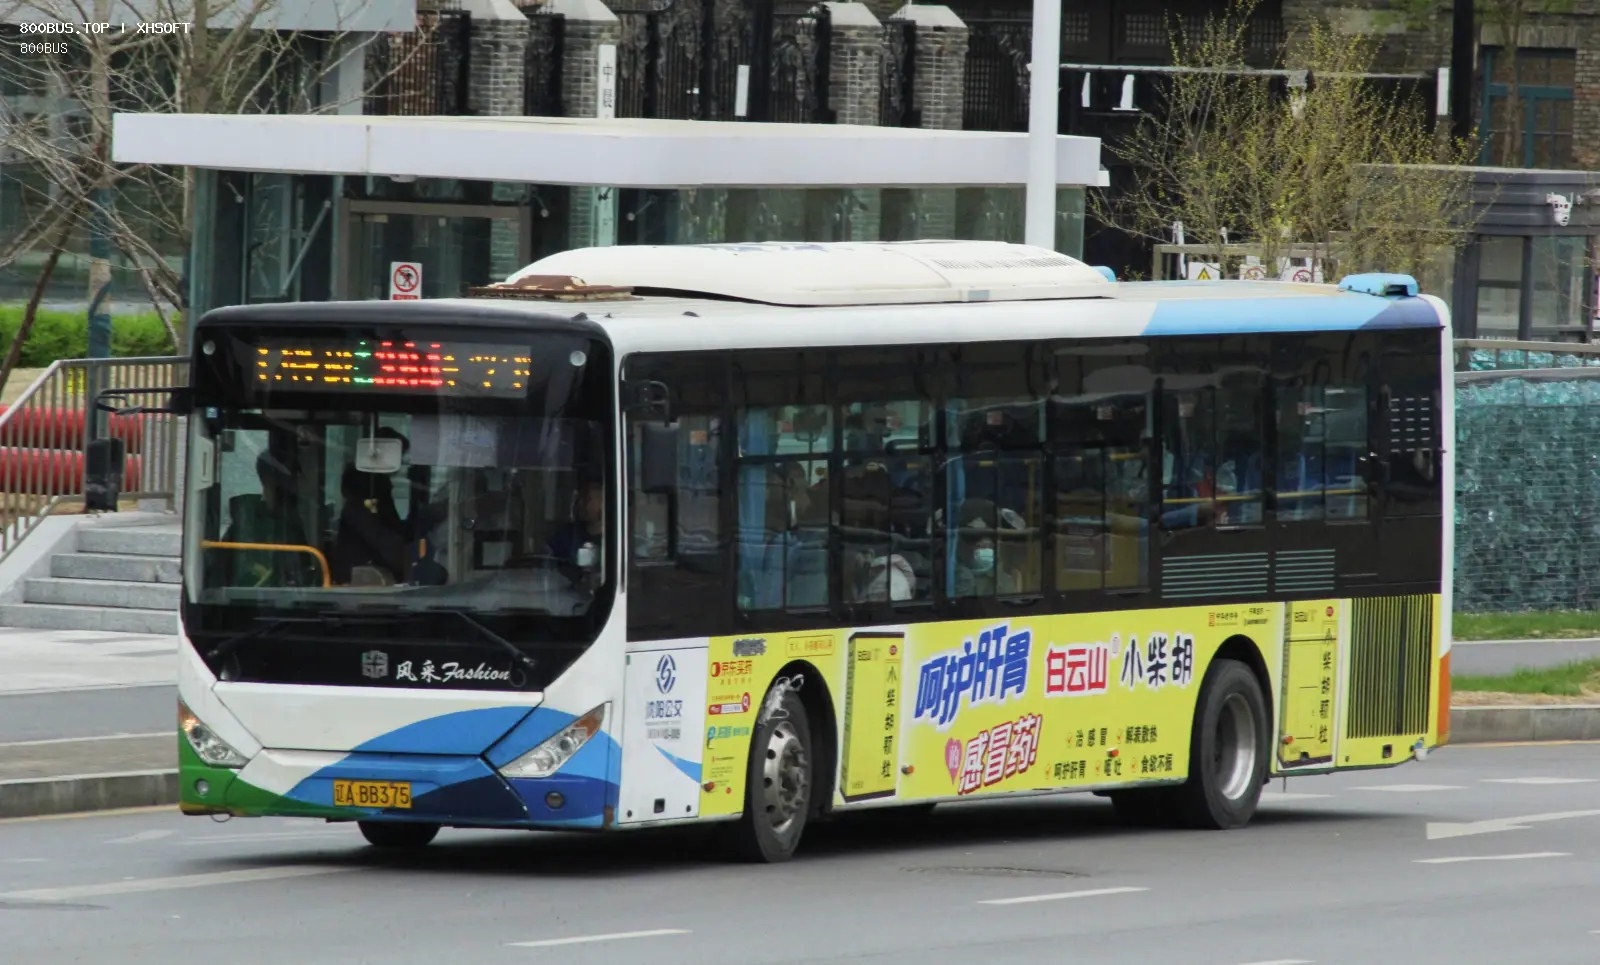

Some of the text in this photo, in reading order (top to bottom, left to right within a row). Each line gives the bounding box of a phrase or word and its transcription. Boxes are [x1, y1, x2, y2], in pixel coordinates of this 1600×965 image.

[395, 659, 511, 684] 风采 Fashion
[913, 624, 1032, 725] 呵护肝胃
[1045, 634, 1193, 694] 白云山 小柴胡
[645, 699, 683, 720] 沈阳公交
[1053, 759, 1087, 781] 呵护肝胃
[1140, 752, 1174, 774] 食欲不振
